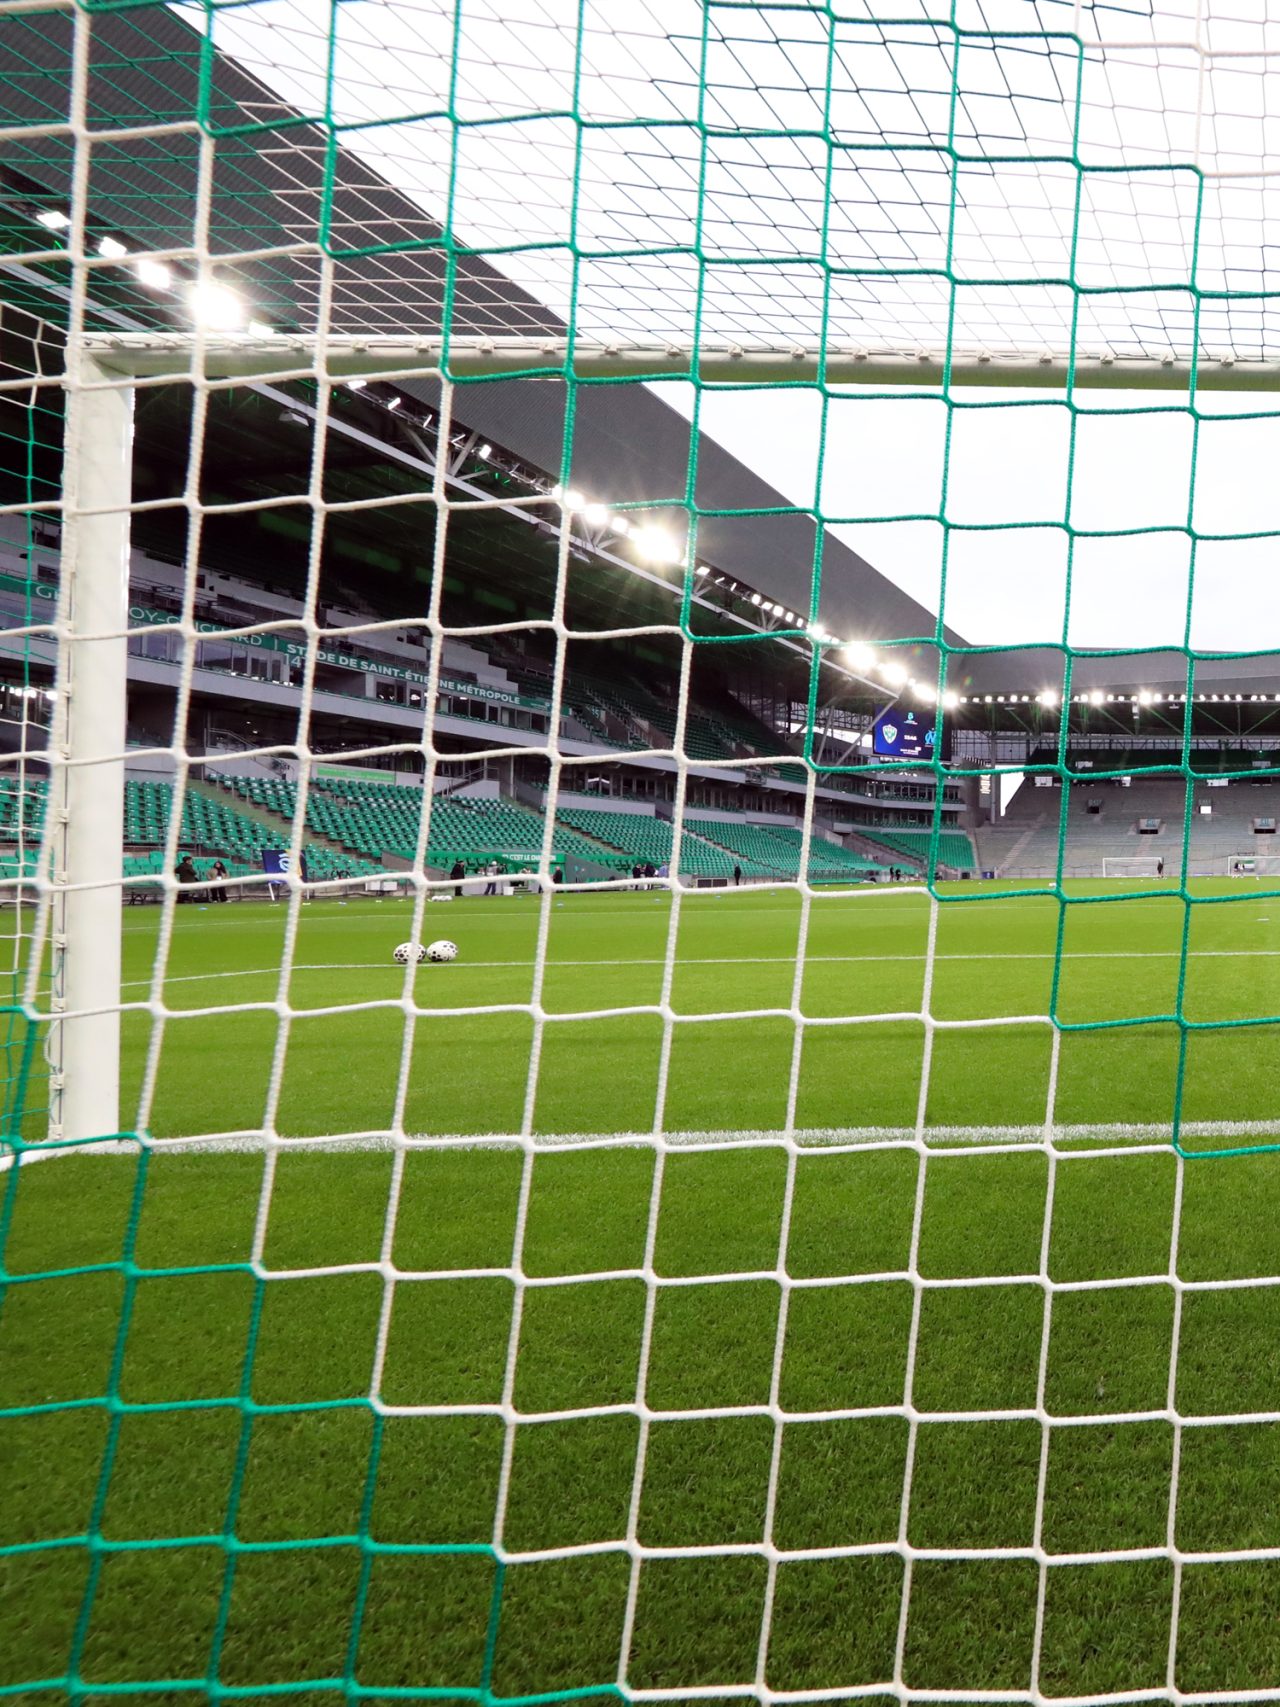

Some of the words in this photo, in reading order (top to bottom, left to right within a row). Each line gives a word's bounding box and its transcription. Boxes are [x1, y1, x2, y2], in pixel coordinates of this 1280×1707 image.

[287, 644, 335, 663] STDE
[339, 655, 358, 668] DE
[361, 661, 454, 690] SAINT-ÉTIENE
[457, 683, 520, 705] MÉTROPOLE
